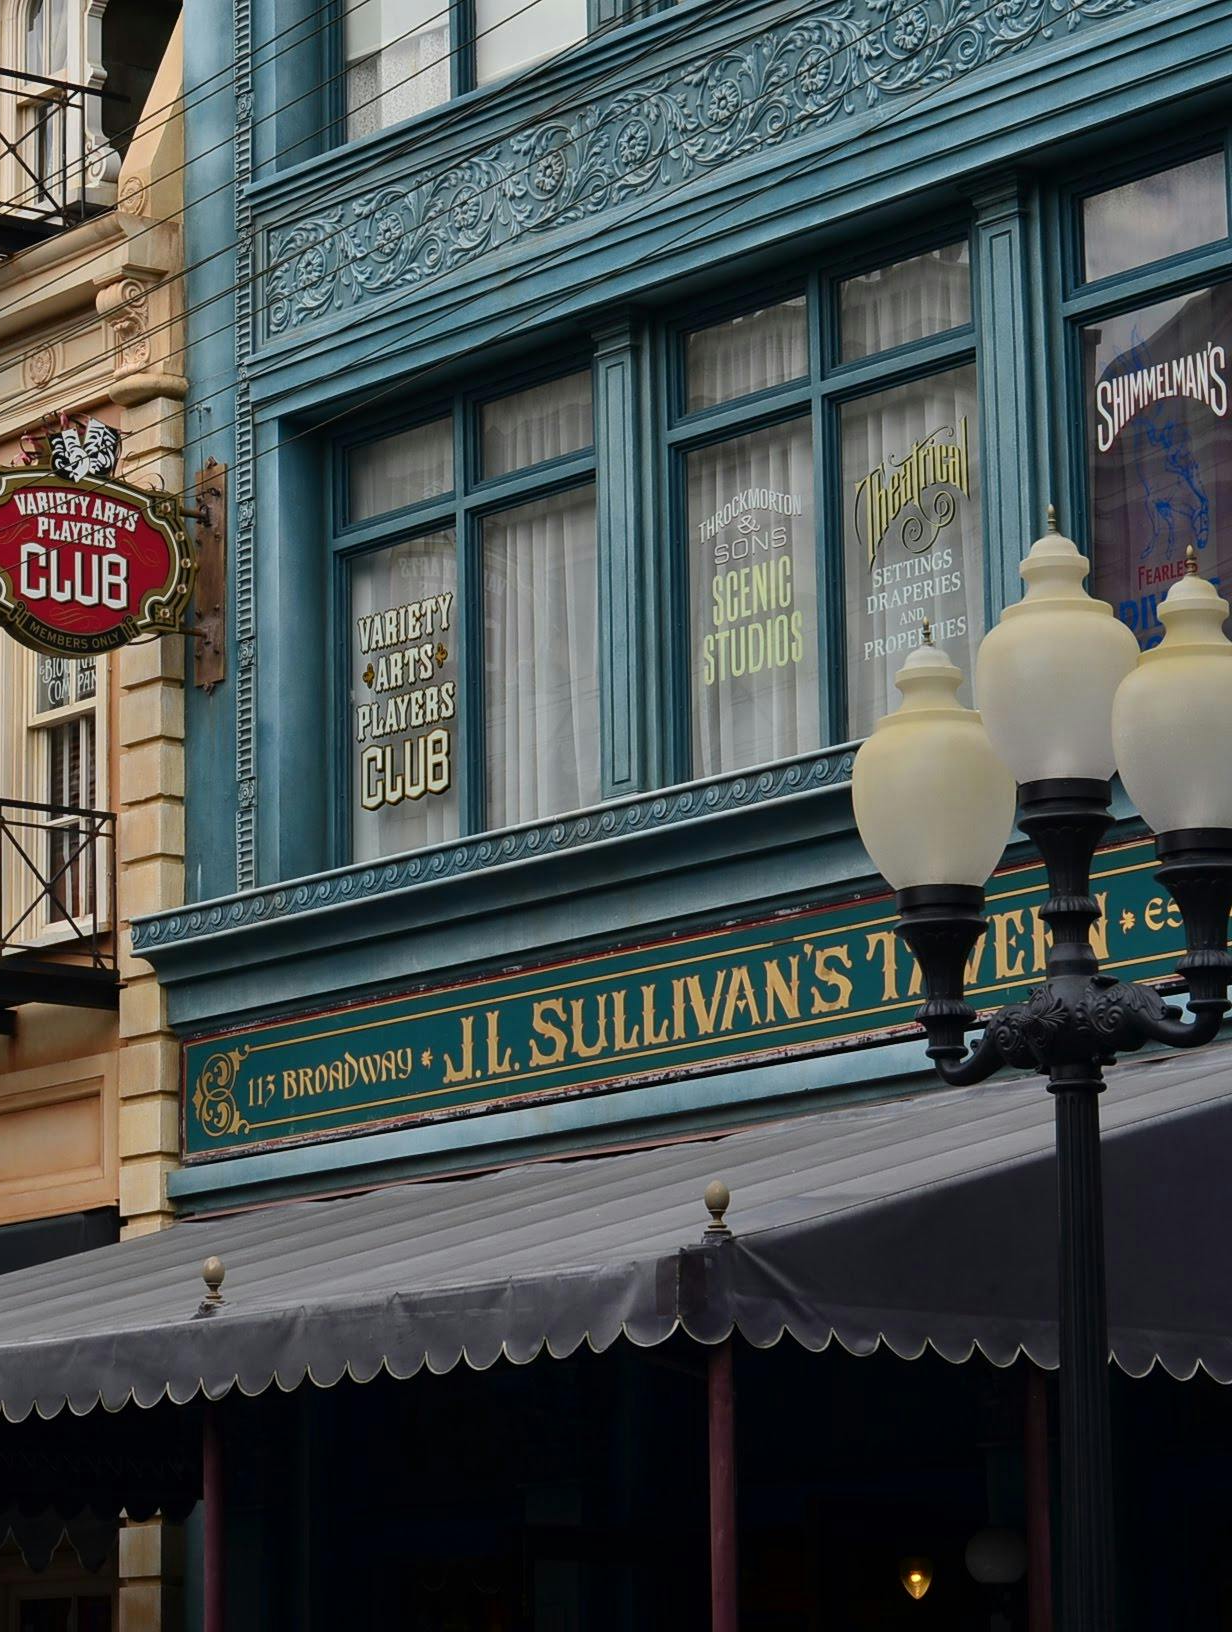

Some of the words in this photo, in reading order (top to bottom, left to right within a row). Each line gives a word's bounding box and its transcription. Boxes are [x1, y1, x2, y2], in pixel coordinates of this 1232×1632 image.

[1096, 341, 1227, 452] SHIMMELMAN'S
[14, 491, 90, 519] VARIETY
[91, 498, 139, 533] ARTS
[698, 487, 802, 544] THROCKMORTON
[855, 415, 971, 570] Theatrical
[37, 516, 116, 549] PLAYERS
[714, 526, 787, 565] SONS
[737, 514, 761, 534] &
[20, 542, 128, 610] CLUB
[712, 555, 792, 627] SCENIC
[866, 571, 961, 615] DRAPERIES
[872, 548, 953, 588] SETTINGS
[28, 621, 89, 650] MEMBERS
[91, 631, 121, 649] ONLY
[356, 591, 453, 654] VARIETY
[899, 607, 925, 626] AND
[375, 642, 434, 693] ARTS
[703, 610, 804, 686] STUDIOS
[356, 680, 456, 742] PLAYERS
[361, 727, 450, 811] CLUB
[282, 1047, 413, 1100] BROADWAY
[529, 941, 854, 1067] SULLIVAN'S
[865, 891, 1111, 1001] TVERN
